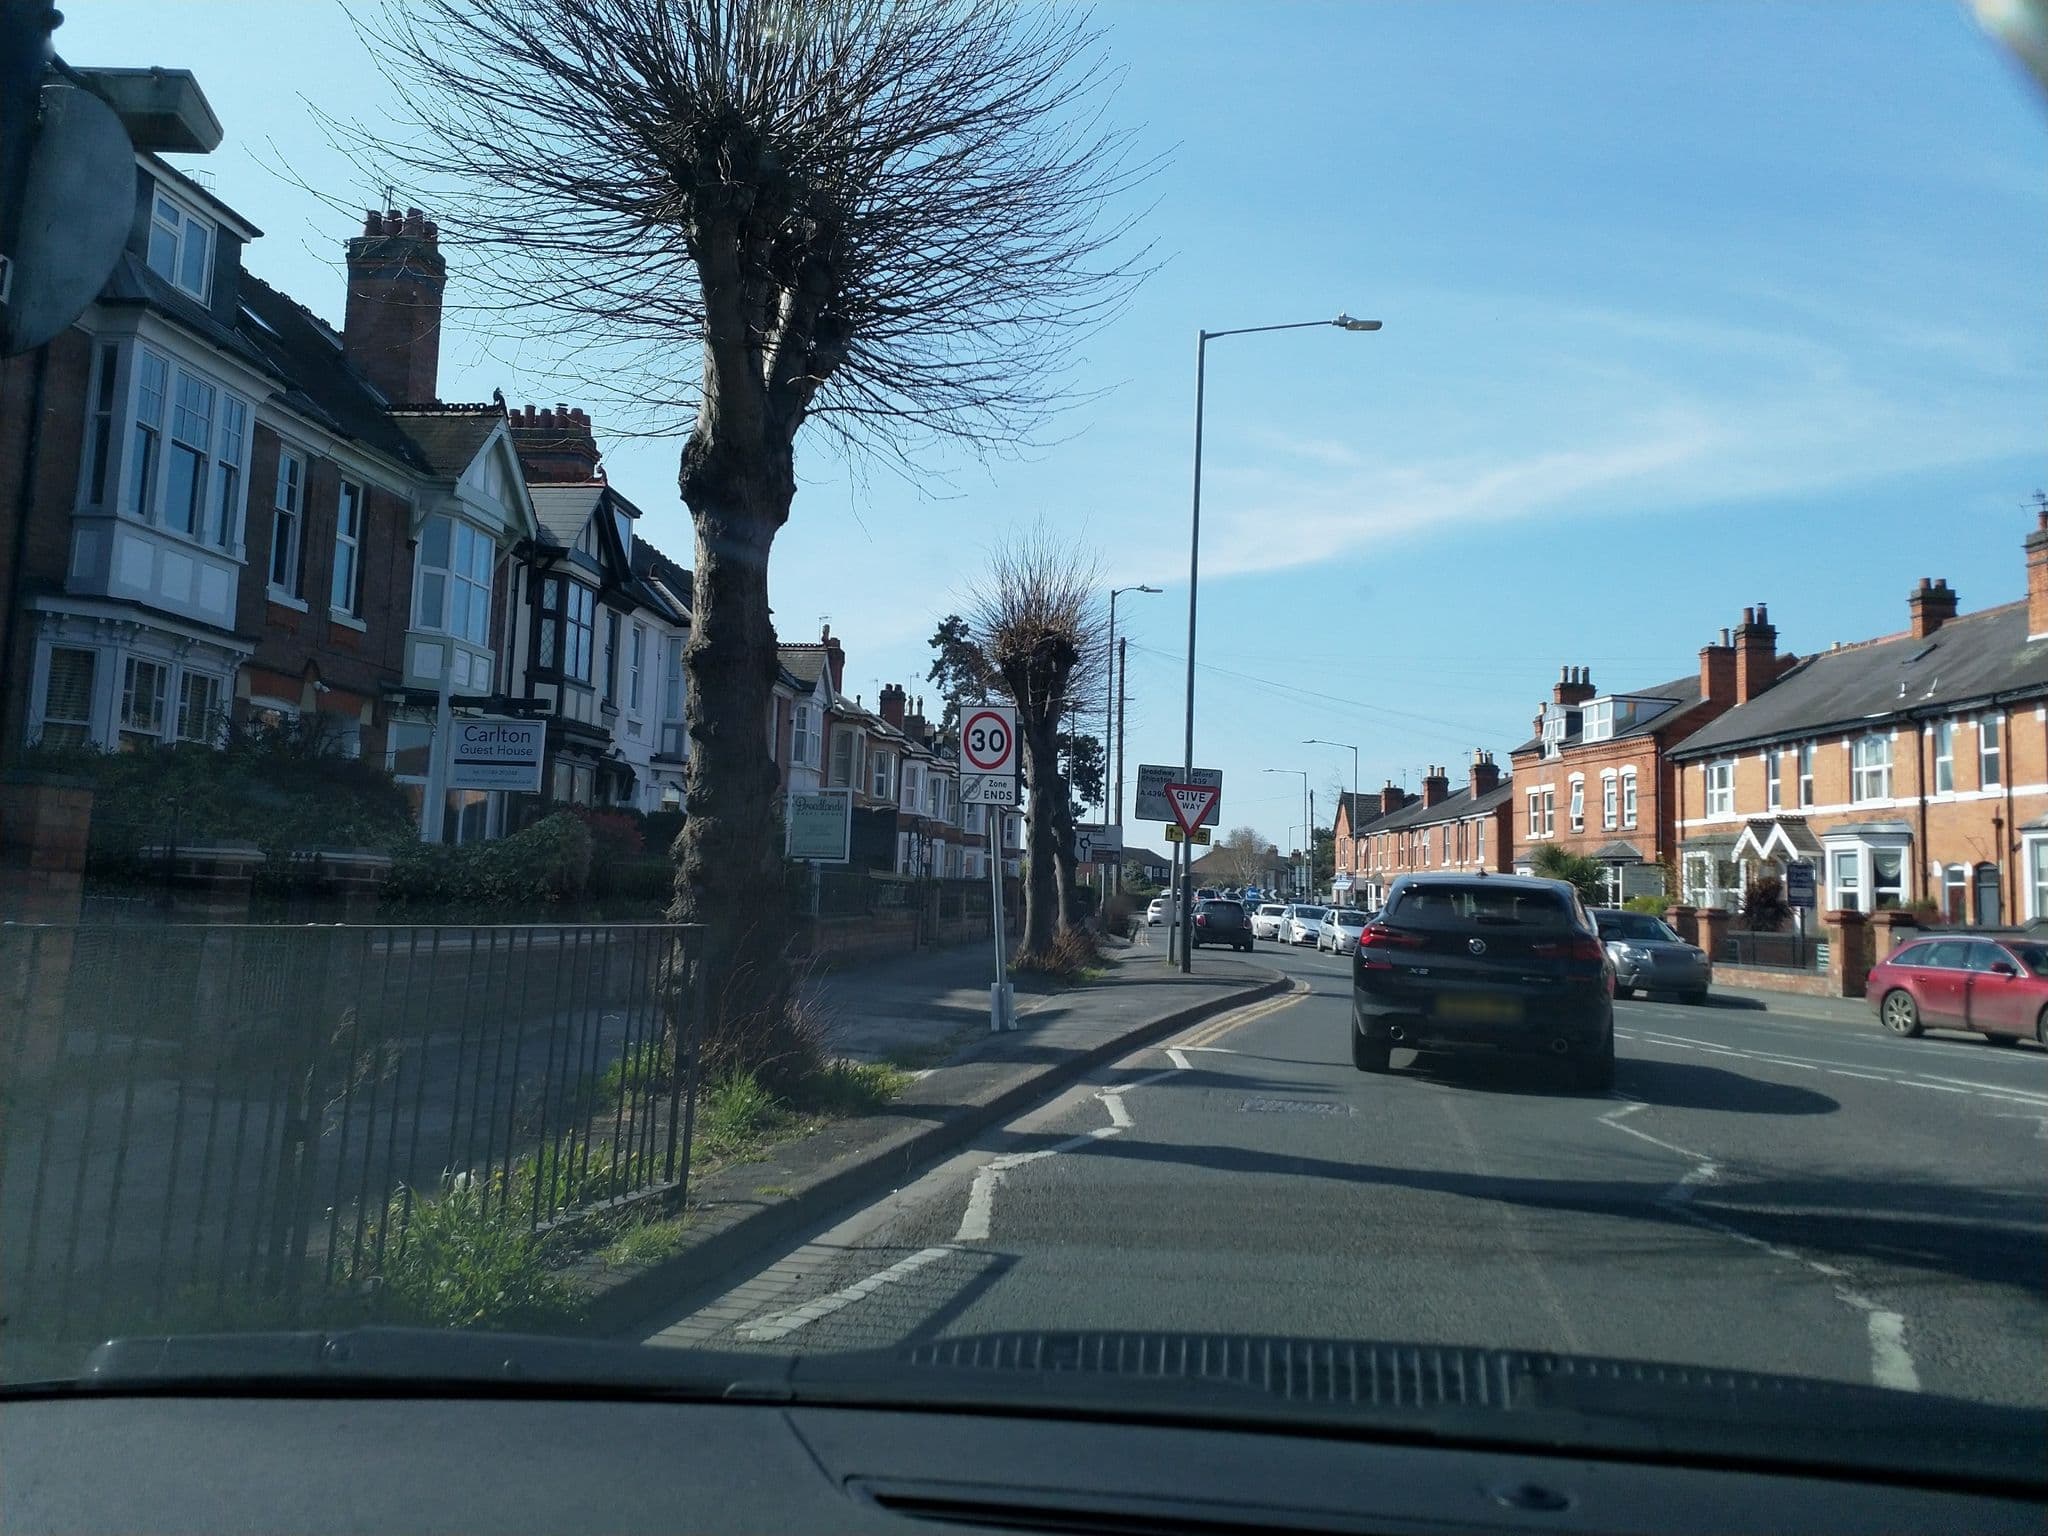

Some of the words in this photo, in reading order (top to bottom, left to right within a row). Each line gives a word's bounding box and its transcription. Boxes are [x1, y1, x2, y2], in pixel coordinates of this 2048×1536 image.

[464, 725, 531, 743] Carlton
[971, 728, 1005, 753] 30
[460, 743, 493, 755] Guest
[497, 744, 533, 756] House
[1141, 767, 1176, 777] Broadway
[988, 780, 1007, 788] Zone
[984, 790, 1012, 800] ENDS
[1176, 791, 1206, 803] GIVE
